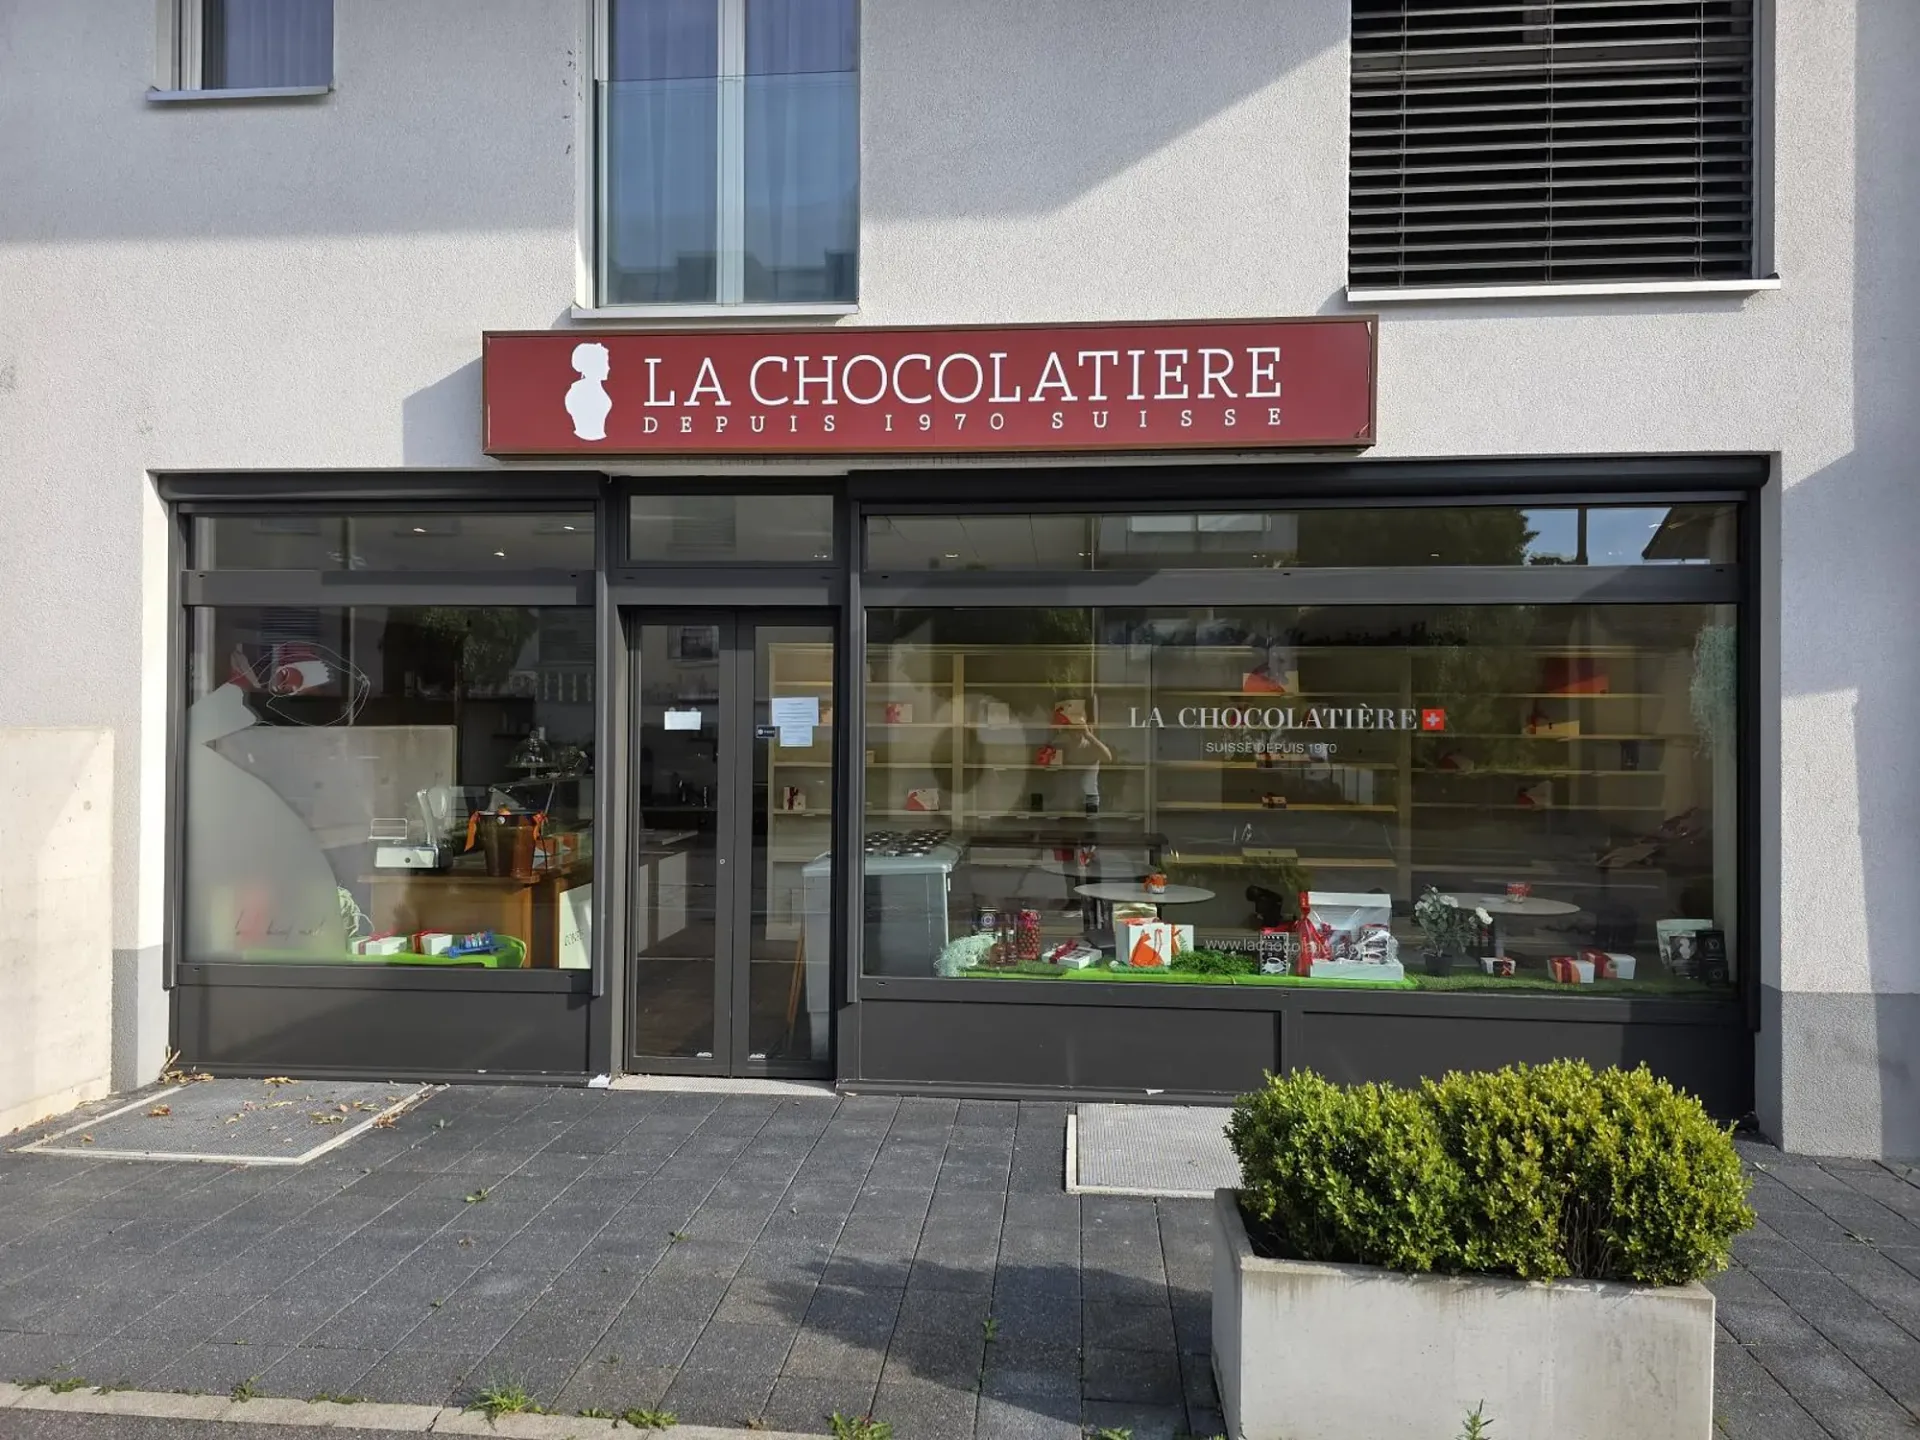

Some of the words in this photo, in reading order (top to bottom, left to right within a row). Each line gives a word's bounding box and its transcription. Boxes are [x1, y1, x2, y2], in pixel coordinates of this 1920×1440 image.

[643, 357, 732, 408] LA
[749, 346, 1282, 406] CHOCOLATIERE
[643, 413, 836, 434] DEPUIS
[884, 412, 1004, 432] 1970
[1051, 410, 1282, 431] SUISSE
[1128, 706, 1165, 729] LA
[1178, 702, 1418, 731] CHOCOLATIÈRE
[1205, 741, 1253, 754] SUISSE
[1256, 742, 1305, 755] DEPUIS
[1308, 743, 1338, 755] 1970
